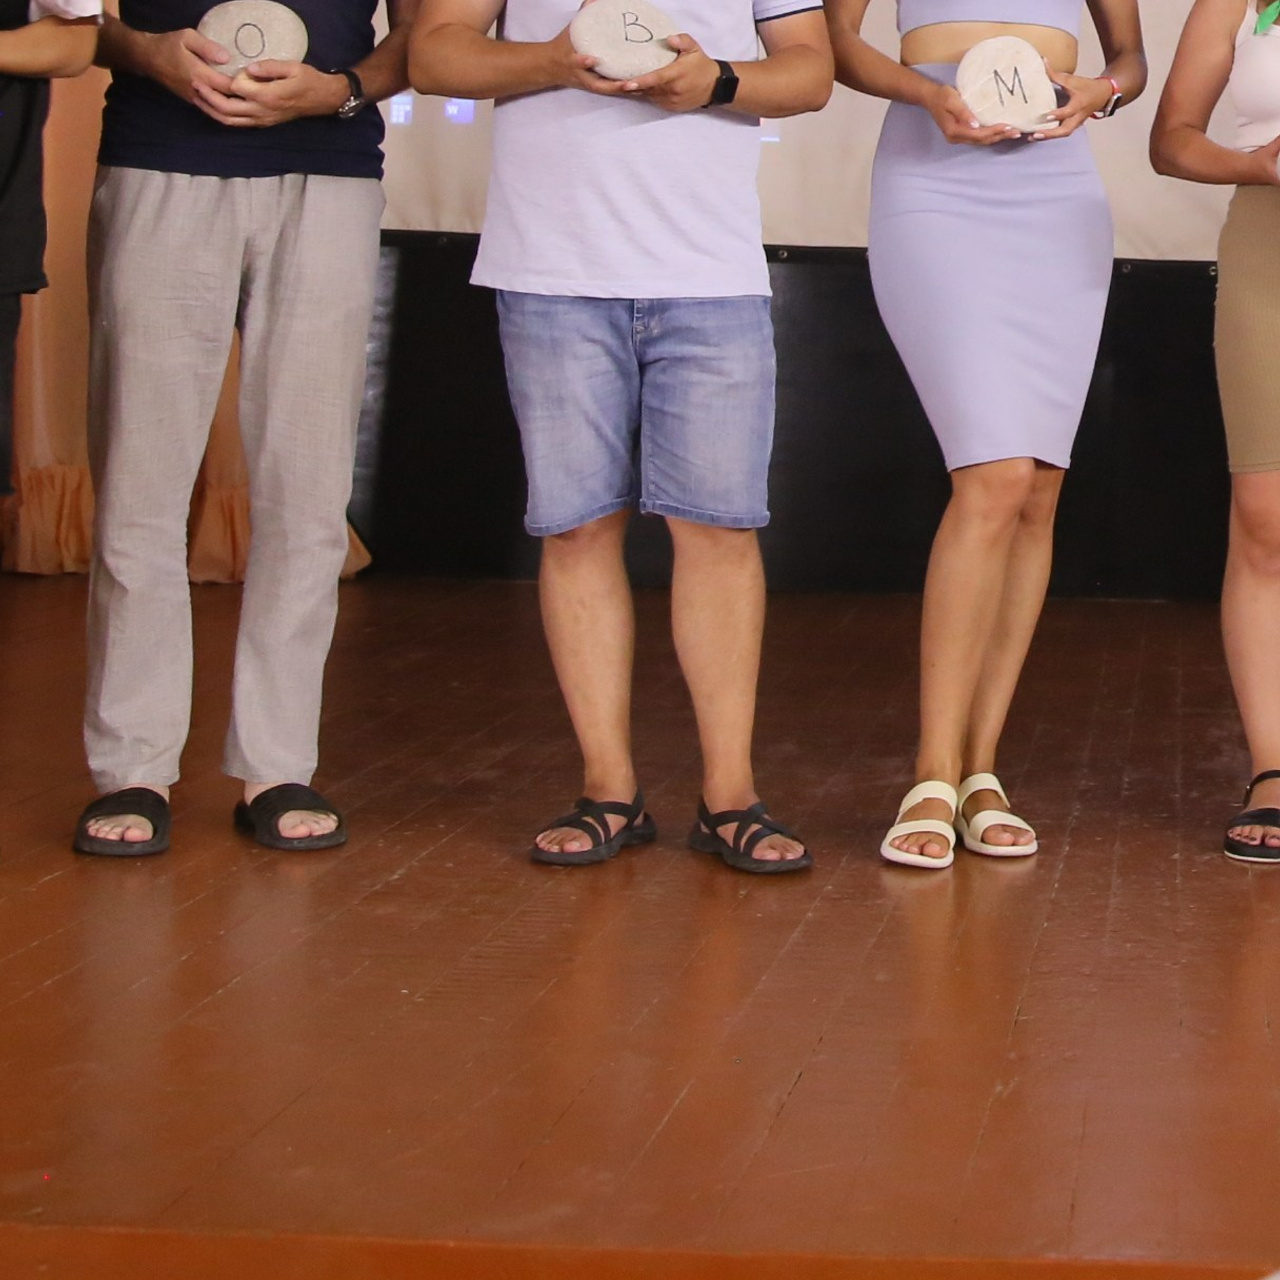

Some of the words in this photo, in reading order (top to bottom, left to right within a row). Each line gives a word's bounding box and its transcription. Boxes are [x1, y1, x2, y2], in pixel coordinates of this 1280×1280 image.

[235, 22, 266, 59] О
[622, 11, 654, 44] В
[993, 66, 1029, 108] М
